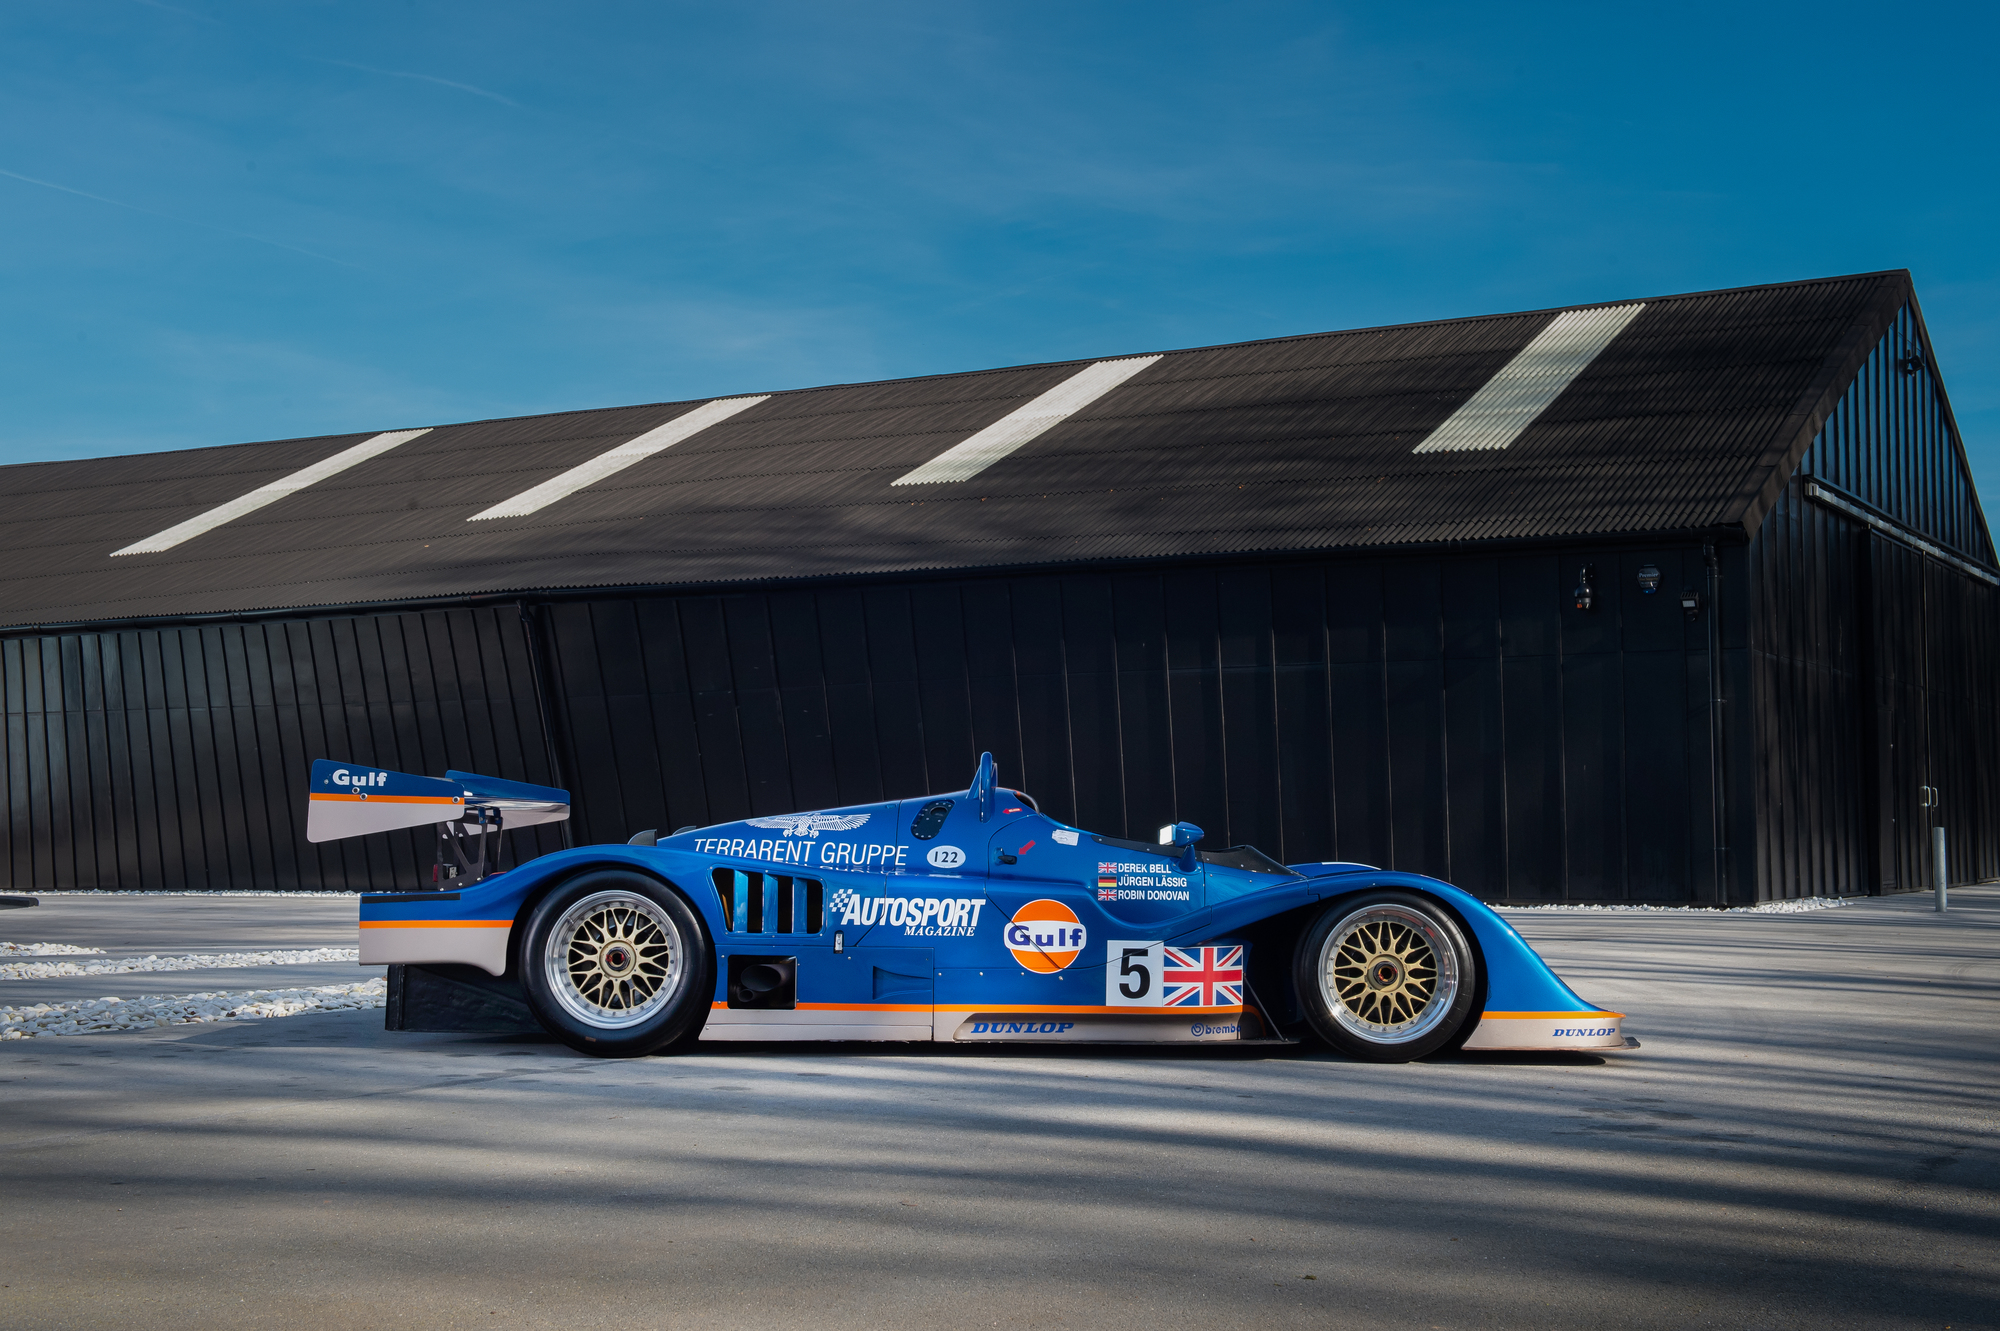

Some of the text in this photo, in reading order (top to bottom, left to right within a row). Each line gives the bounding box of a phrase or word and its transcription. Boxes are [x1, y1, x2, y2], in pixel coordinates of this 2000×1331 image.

[332, 769, 388, 787] Gulf
[694, 838, 910, 866] TERRARENT GRUPPE
[934, 851, 958, 863] 122
[1118, 863, 1172, 874] DEREK BELL
[1118, 874, 1187, 887] JÜRGEN LÄSSIG
[1118, 889, 1190, 901] ROBIN DONOVAN
[841, 893, 987, 927] AUTOSPORT
[904, 926, 976, 937] MAGAZINE
[1007, 925, 1083, 947] Gulf
[1118, 947, 1151, 999] 5
[970, 1022, 1075, 1034] DUNLOP
[1205, 1023, 1242, 1035] brembo
[1552, 1027, 1616, 1037] DUNLOP
